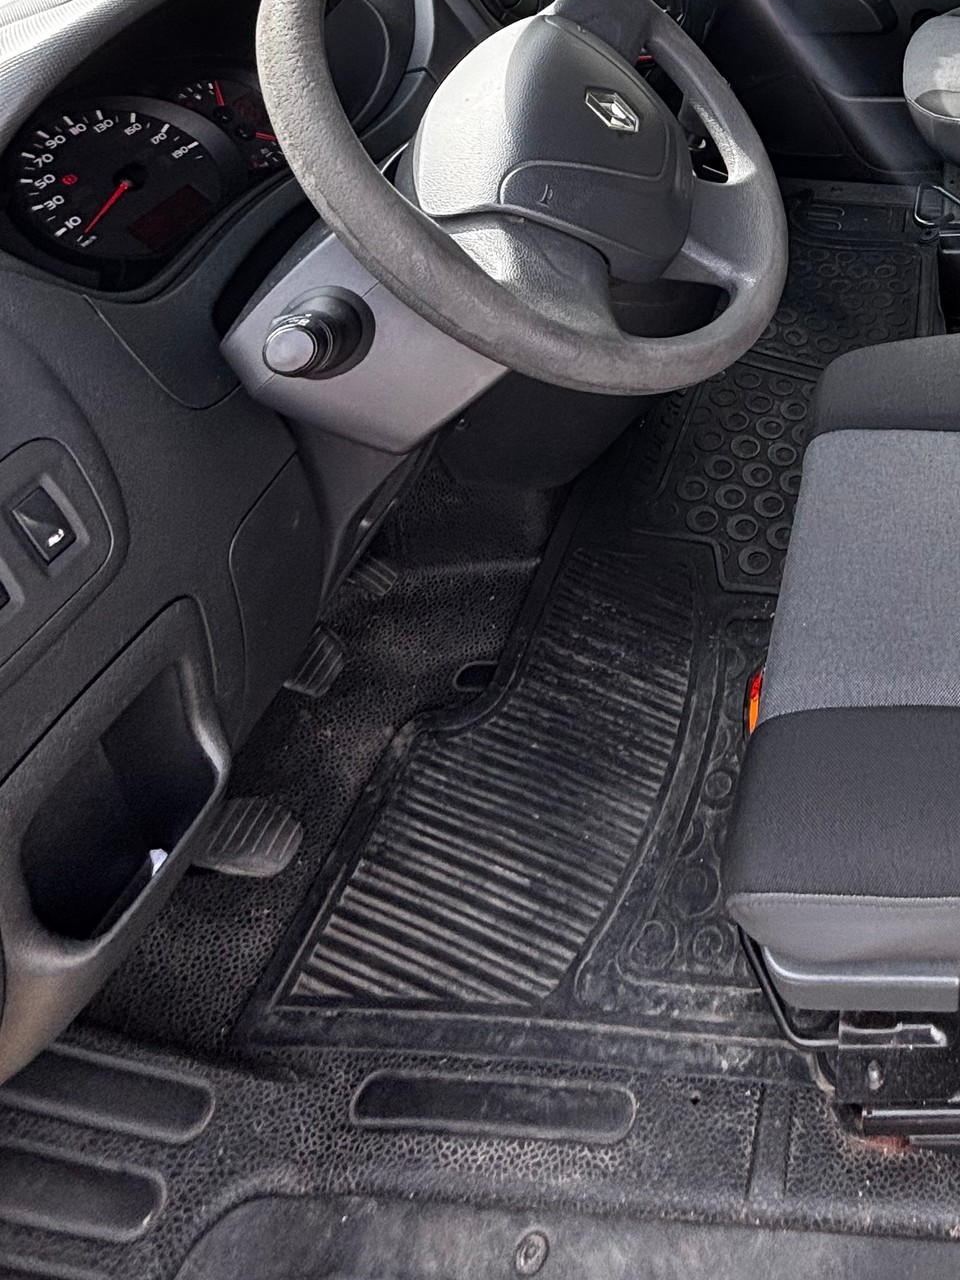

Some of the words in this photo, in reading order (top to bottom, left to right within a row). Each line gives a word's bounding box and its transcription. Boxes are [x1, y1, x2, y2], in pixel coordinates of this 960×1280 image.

[69, 123, 87, 136] 110
[92, 119, 114, 133] 130
[124, 122, 143, 136] 150
[45, 135, 66, 150] 90
[150, 132, 168, 145] 170
[171, 146, 189, 159] 190
[33, 153, 54, 168] 70
[34, 174, 56, 190] 50
[43, 195, 65, 211] 30
[64, 216, 82, 230] 10
